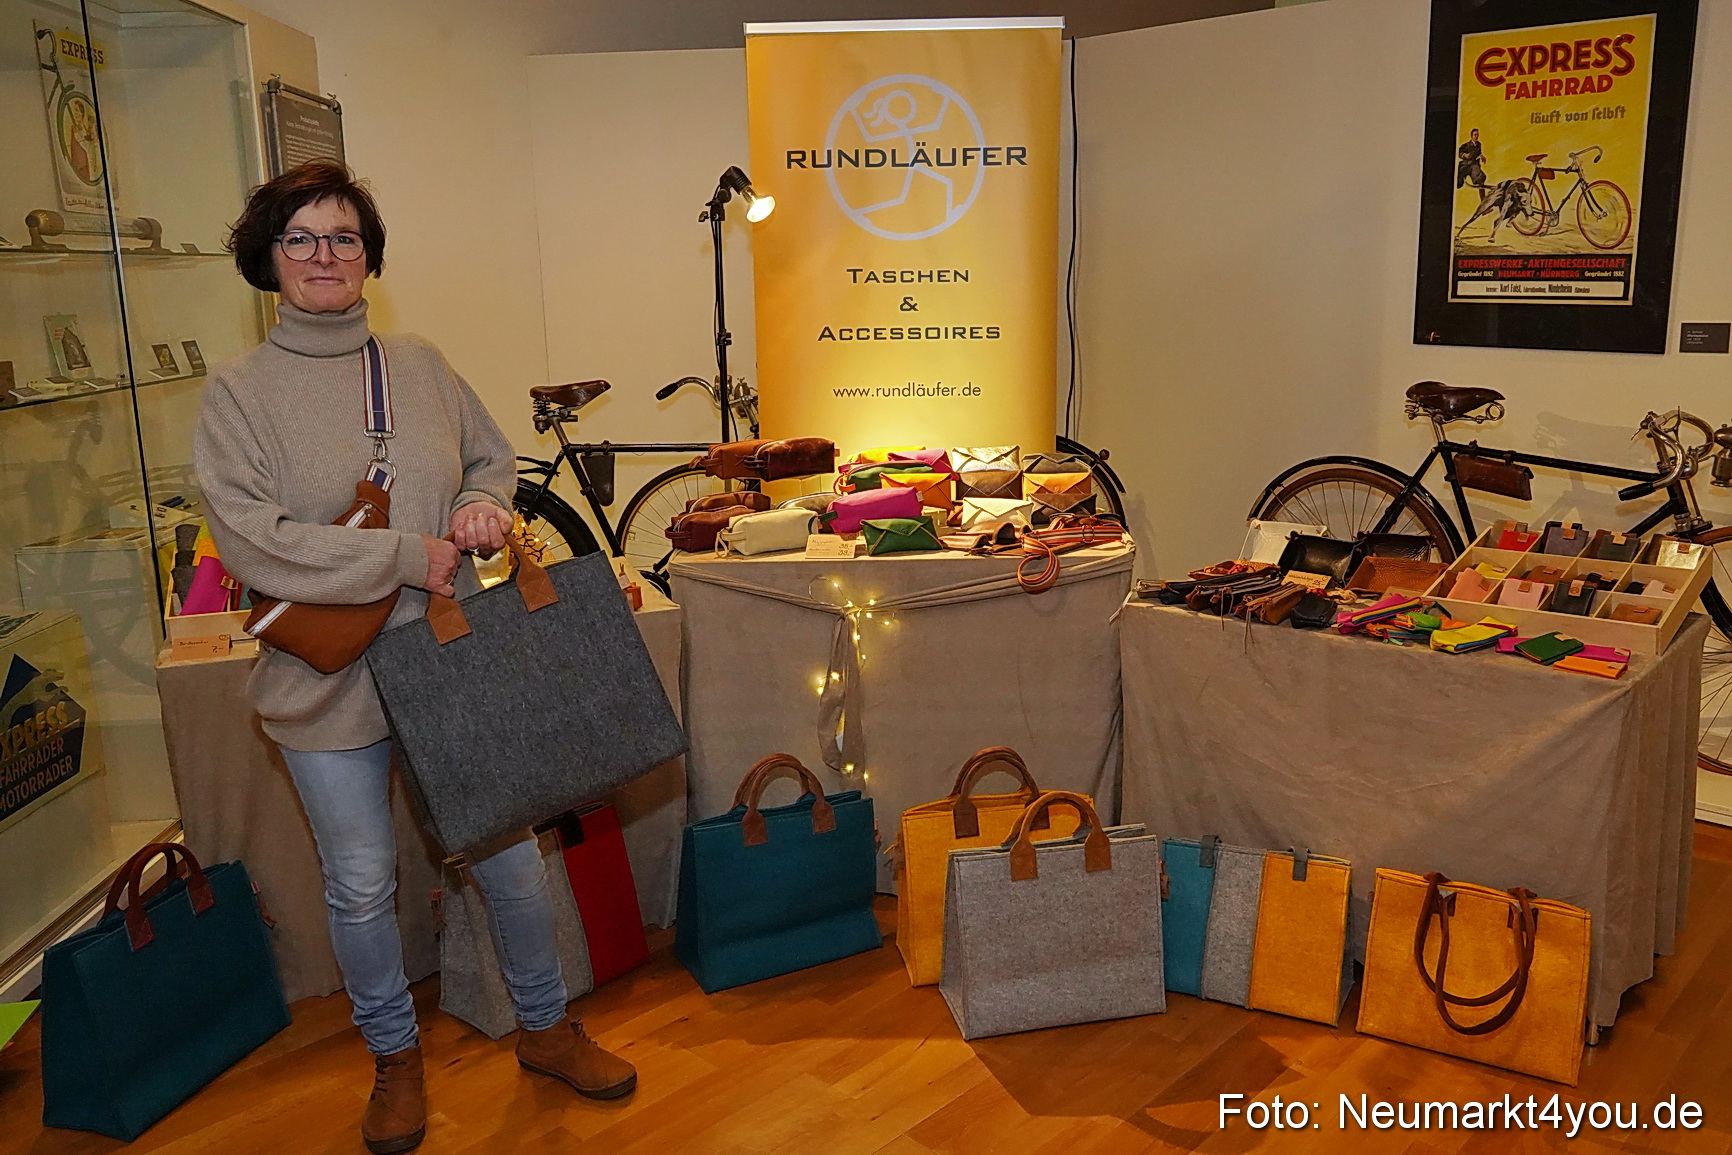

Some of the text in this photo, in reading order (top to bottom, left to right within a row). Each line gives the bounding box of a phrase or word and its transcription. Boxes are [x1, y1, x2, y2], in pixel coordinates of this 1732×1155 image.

[60, 38, 104, 65] EXPRSS
[1475, 34, 1635, 87] EXPRESS
[1504, 75, 1614, 100] FAHRRAD
[1530, 111, 1561, 125] läuft
[1565, 111, 1589, 122] von
[786, 141, 1028, 169] RUNDLÄUFER
[1498, 269, 1580, 278] NEUMARKT NÜRNBERG
[899, 296, 919, 312] &
[832, 381, 982, 398] www.rundläufer.de
[0, 700, 67, 762] XPRESS
